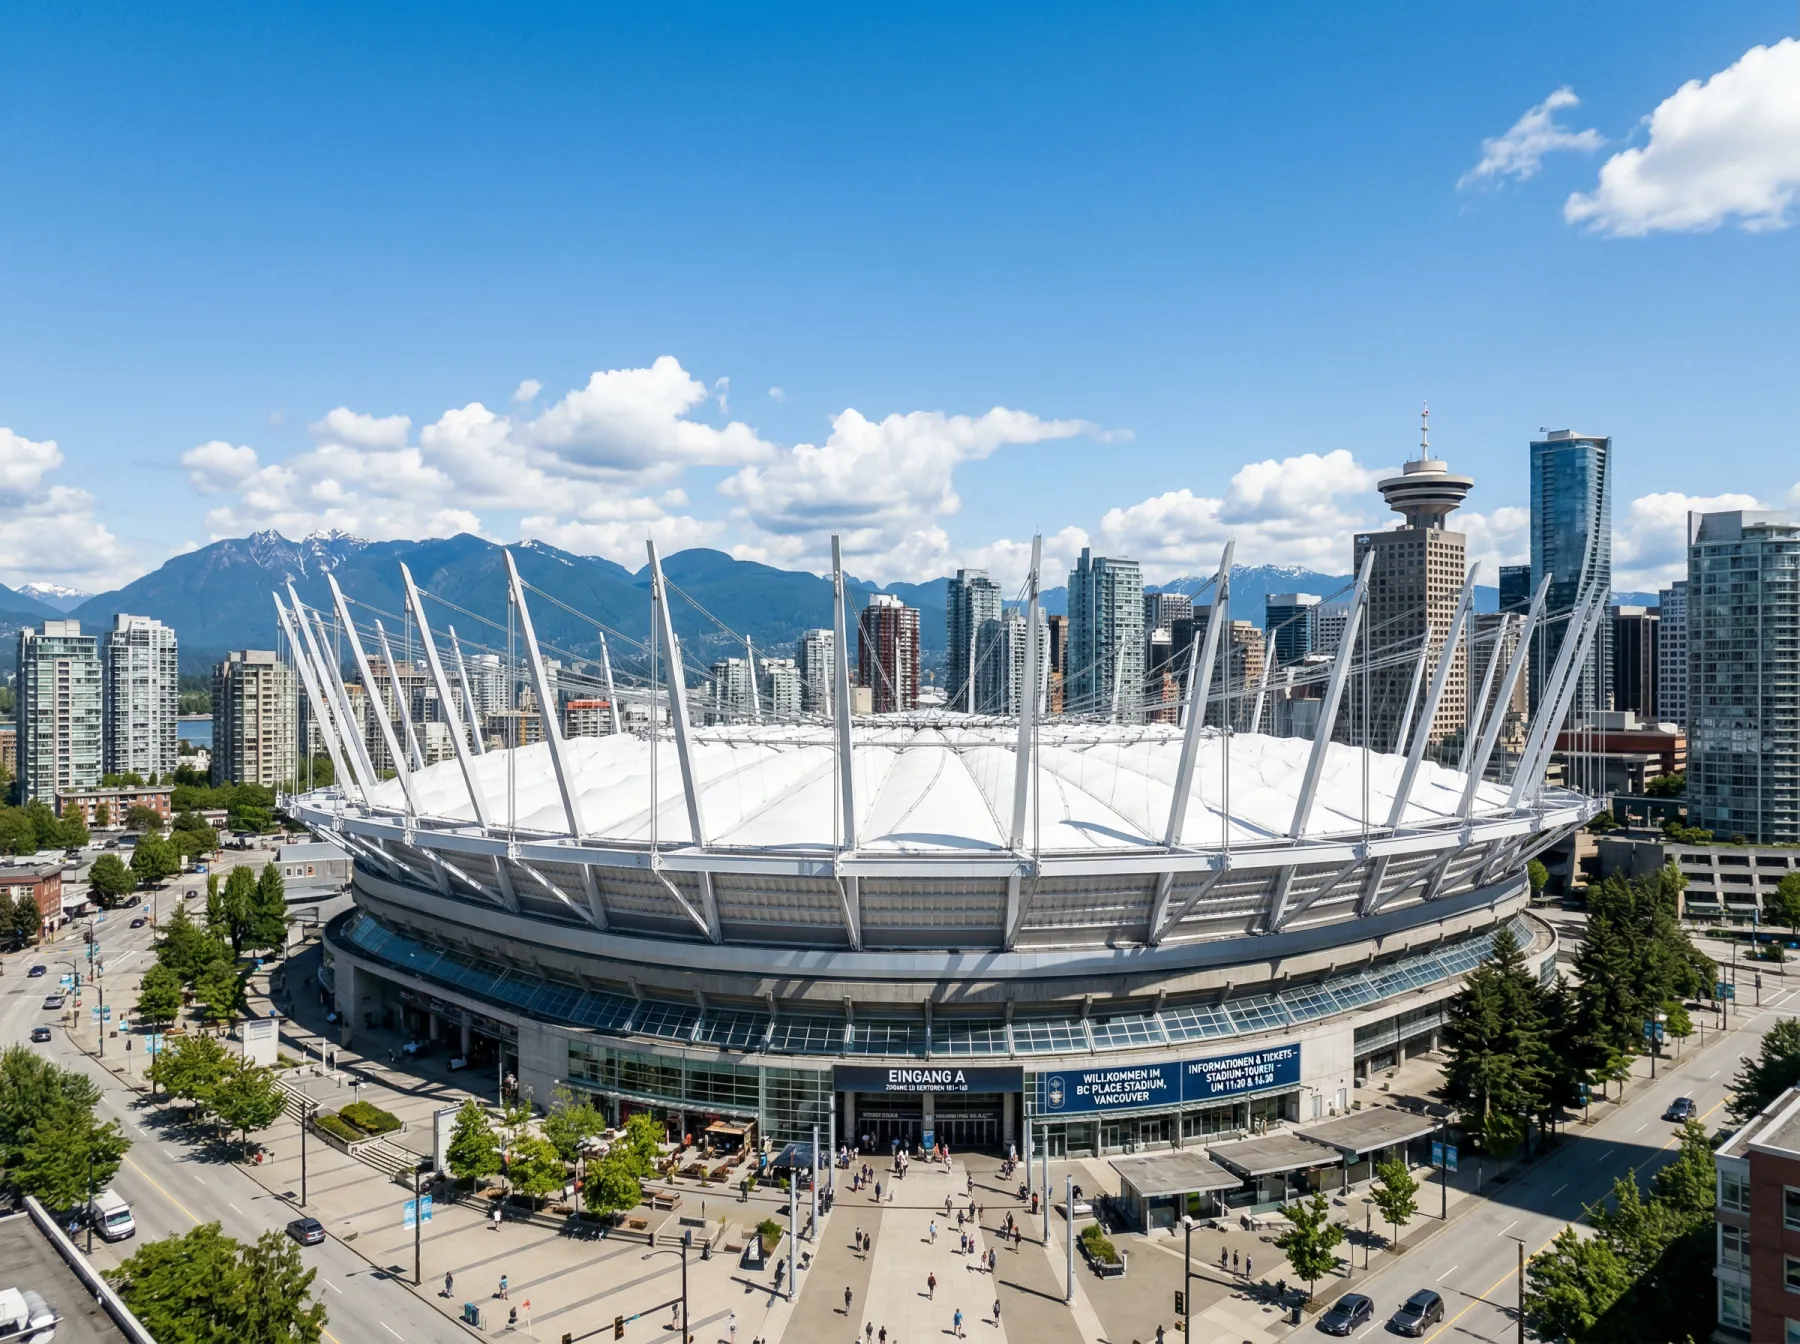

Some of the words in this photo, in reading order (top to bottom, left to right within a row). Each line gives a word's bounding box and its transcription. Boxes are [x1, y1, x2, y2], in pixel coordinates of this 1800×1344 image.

[1188, 1056, 1254, 1074] INFORMATIONEN
[889, 1070, 951, 1083] EINGANG
[954, 1070, 965, 1083] A
[1083, 1069, 1147, 1084] WILLKOMMEN
[1149, 1068, 1160, 1079] IM
[1077, 1085, 1089, 1095] BC
[1092, 1083, 1122, 1094] PLACE
[1124, 1079, 1166, 1092] STADIUM,
[1094, 1092, 1149, 1105] VANCOUVER
